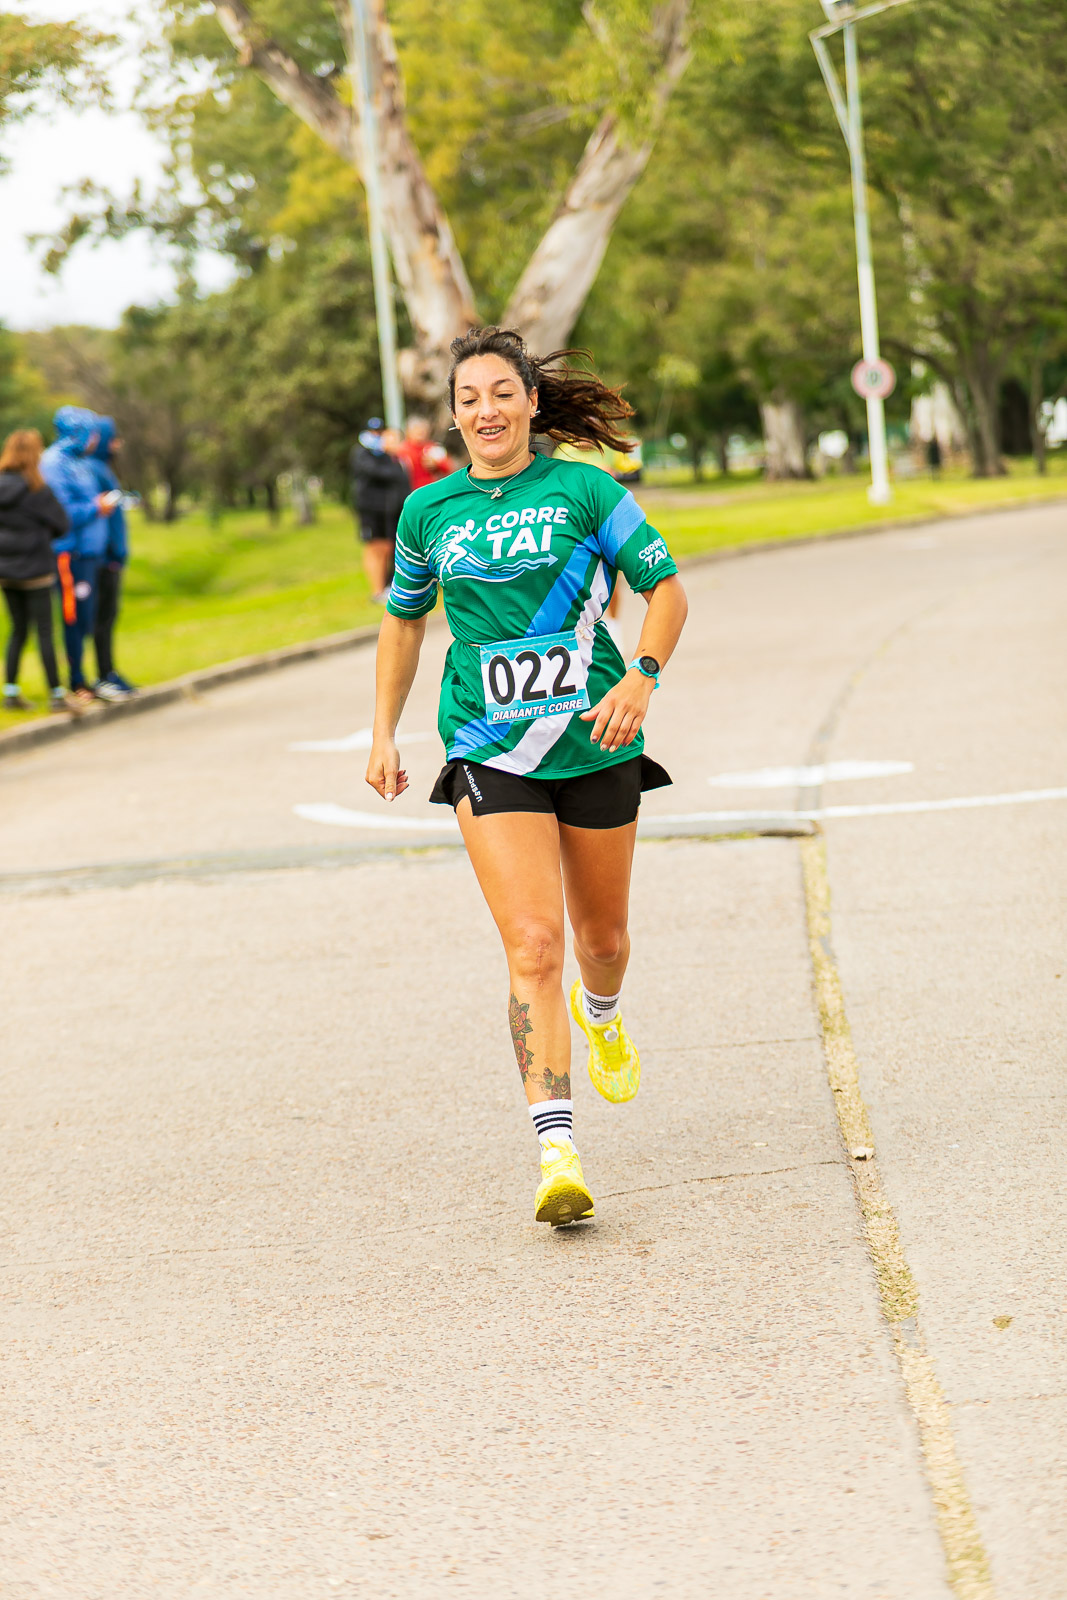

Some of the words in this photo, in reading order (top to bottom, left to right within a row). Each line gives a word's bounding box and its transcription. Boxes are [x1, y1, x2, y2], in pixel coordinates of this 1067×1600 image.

[485, 506, 569, 532] CORRE
[486, 525, 553, 560] TAI
[638, 537, 665, 560] CORRE
[644, 545, 668, 569] TAI
[488, 645, 577, 706] 022
[492, 705, 546, 721] DIAMANTE
[548, 698, 583, 713] CORRE
